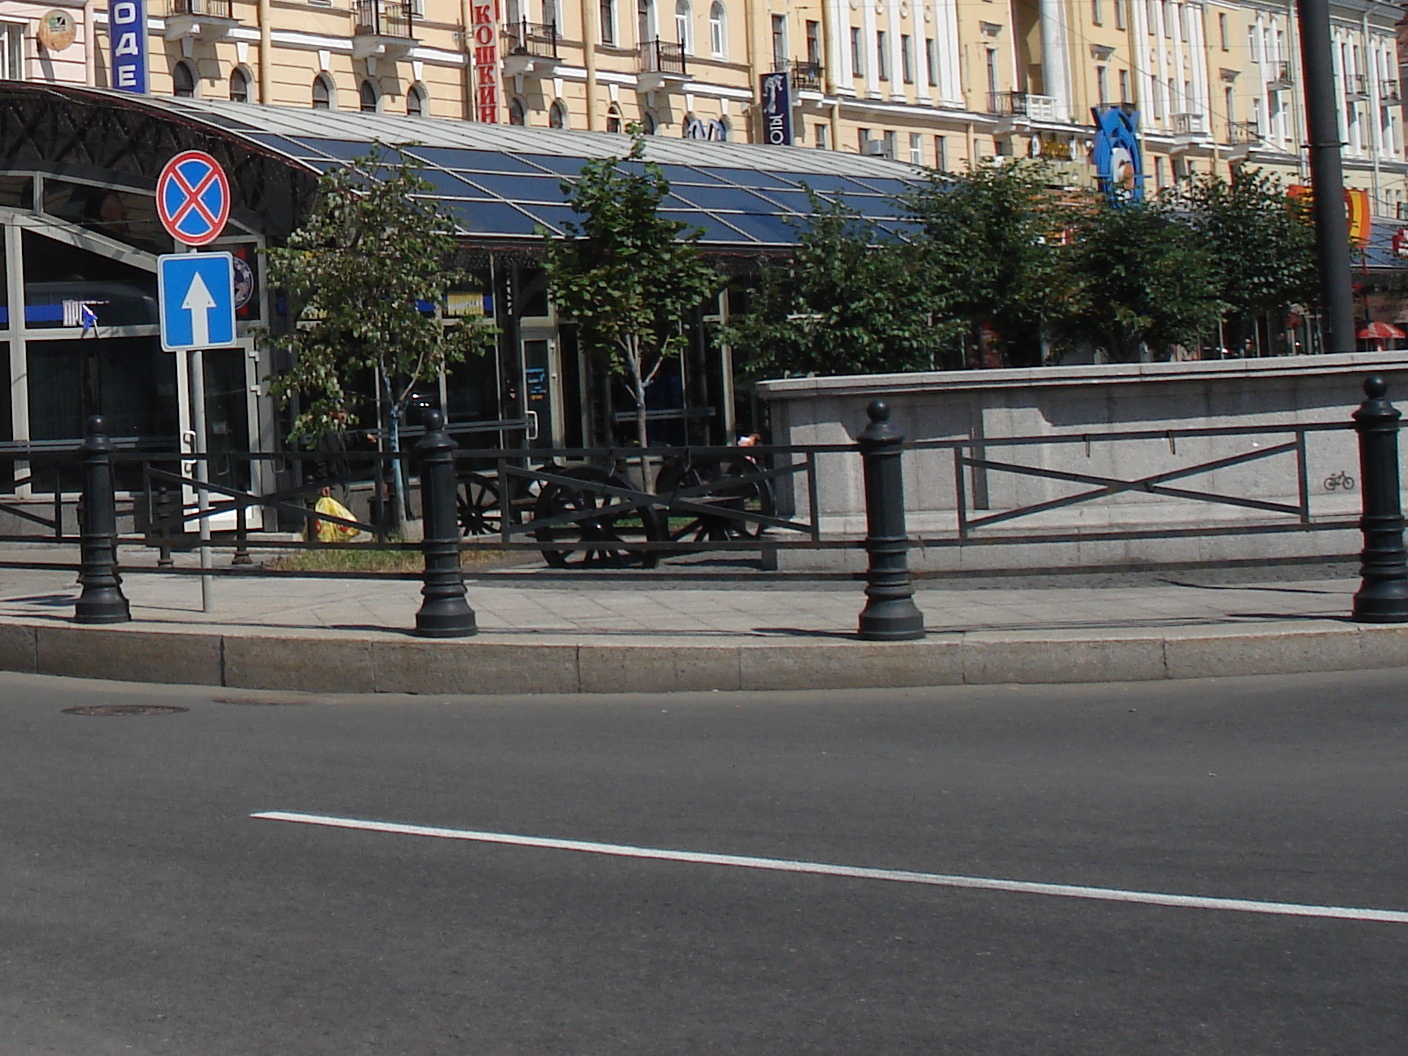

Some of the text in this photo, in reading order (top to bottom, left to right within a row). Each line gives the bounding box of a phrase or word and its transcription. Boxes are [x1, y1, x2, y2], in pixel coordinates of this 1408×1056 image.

[114, 2, 139, 87] ОДЕ
[474, 5, 497, 124] КОШКИН
[769, 113, 784, 145] ОТЫ
